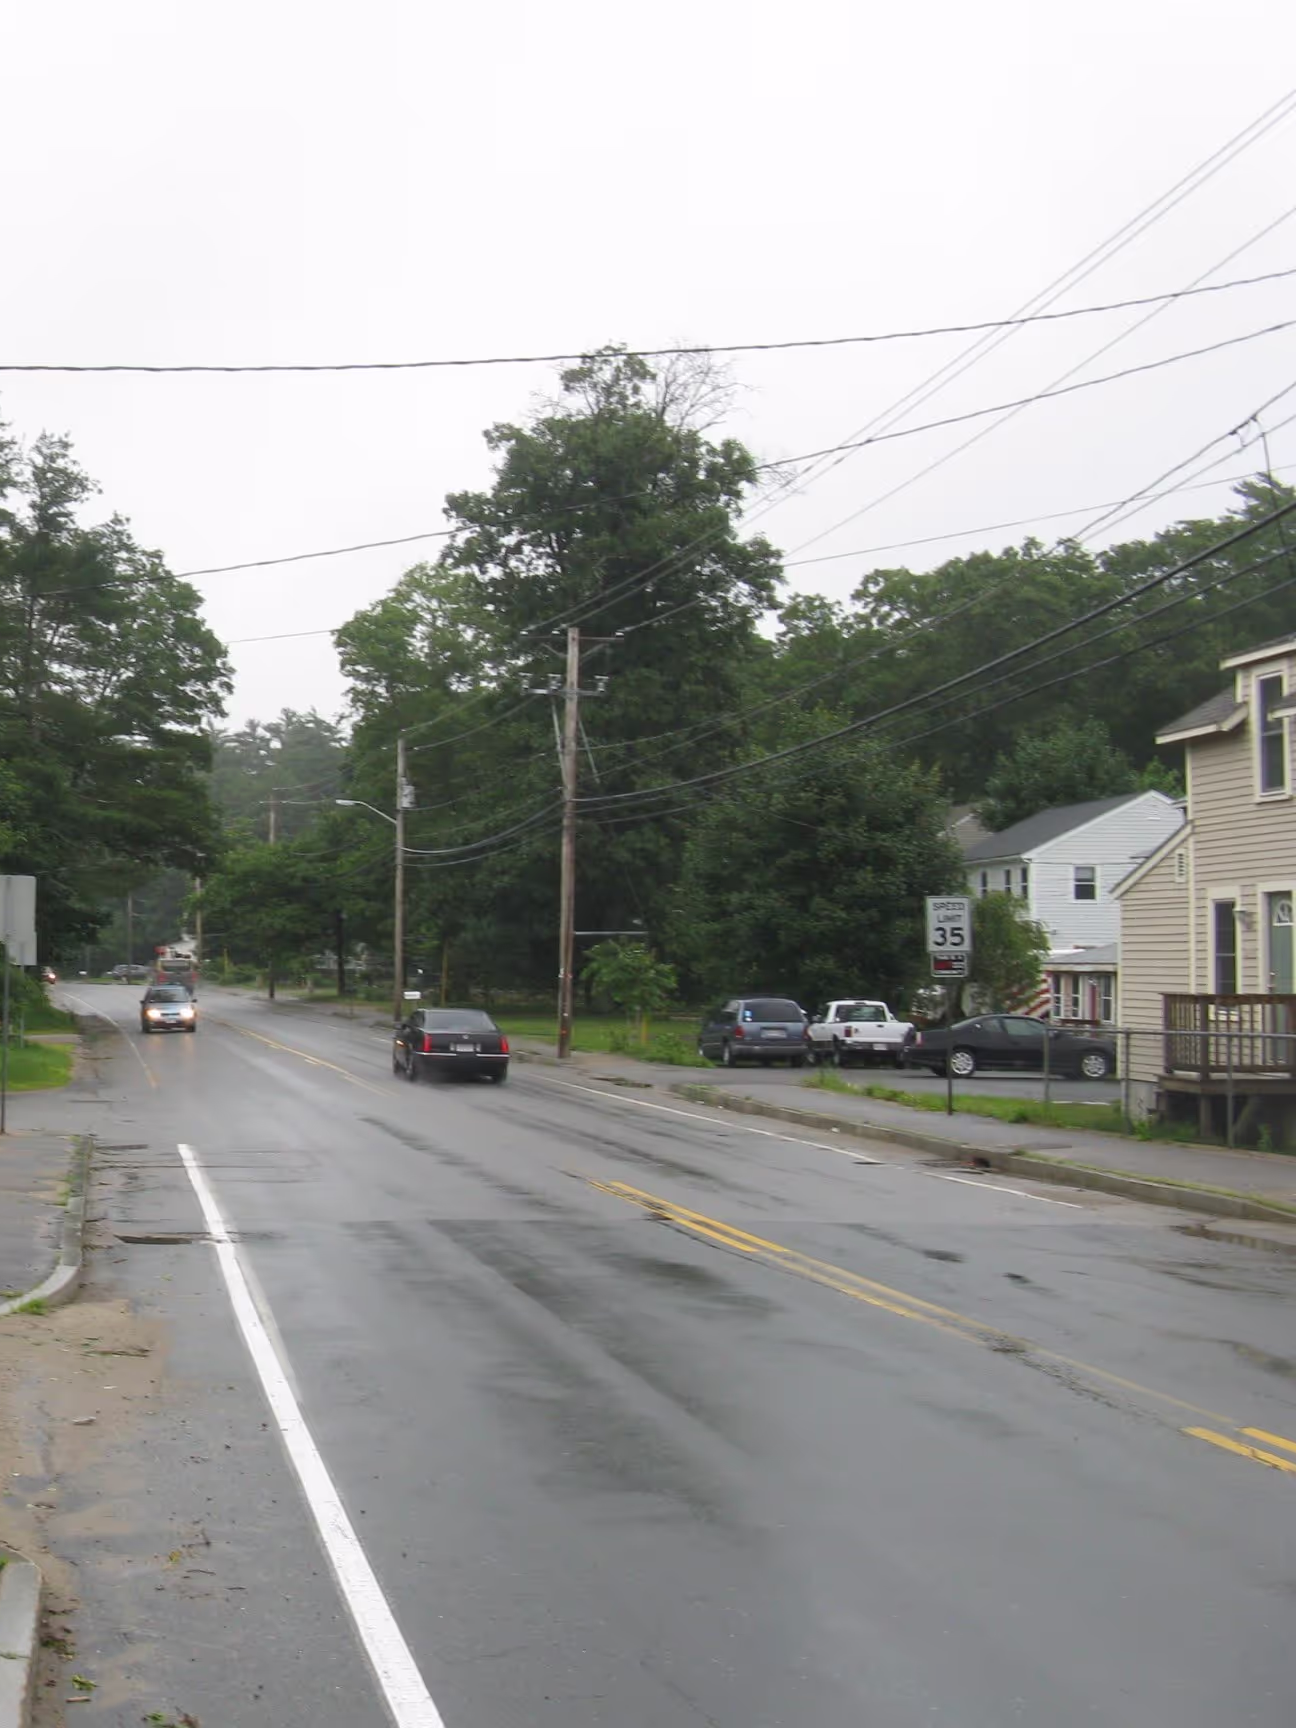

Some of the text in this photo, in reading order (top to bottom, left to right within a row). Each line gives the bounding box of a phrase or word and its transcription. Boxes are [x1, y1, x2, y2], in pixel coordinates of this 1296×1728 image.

[933, 902, 965, 911] SPEED
[937, 914, 962, 923] LIMIT
[933, 927, 965, 947] 35
